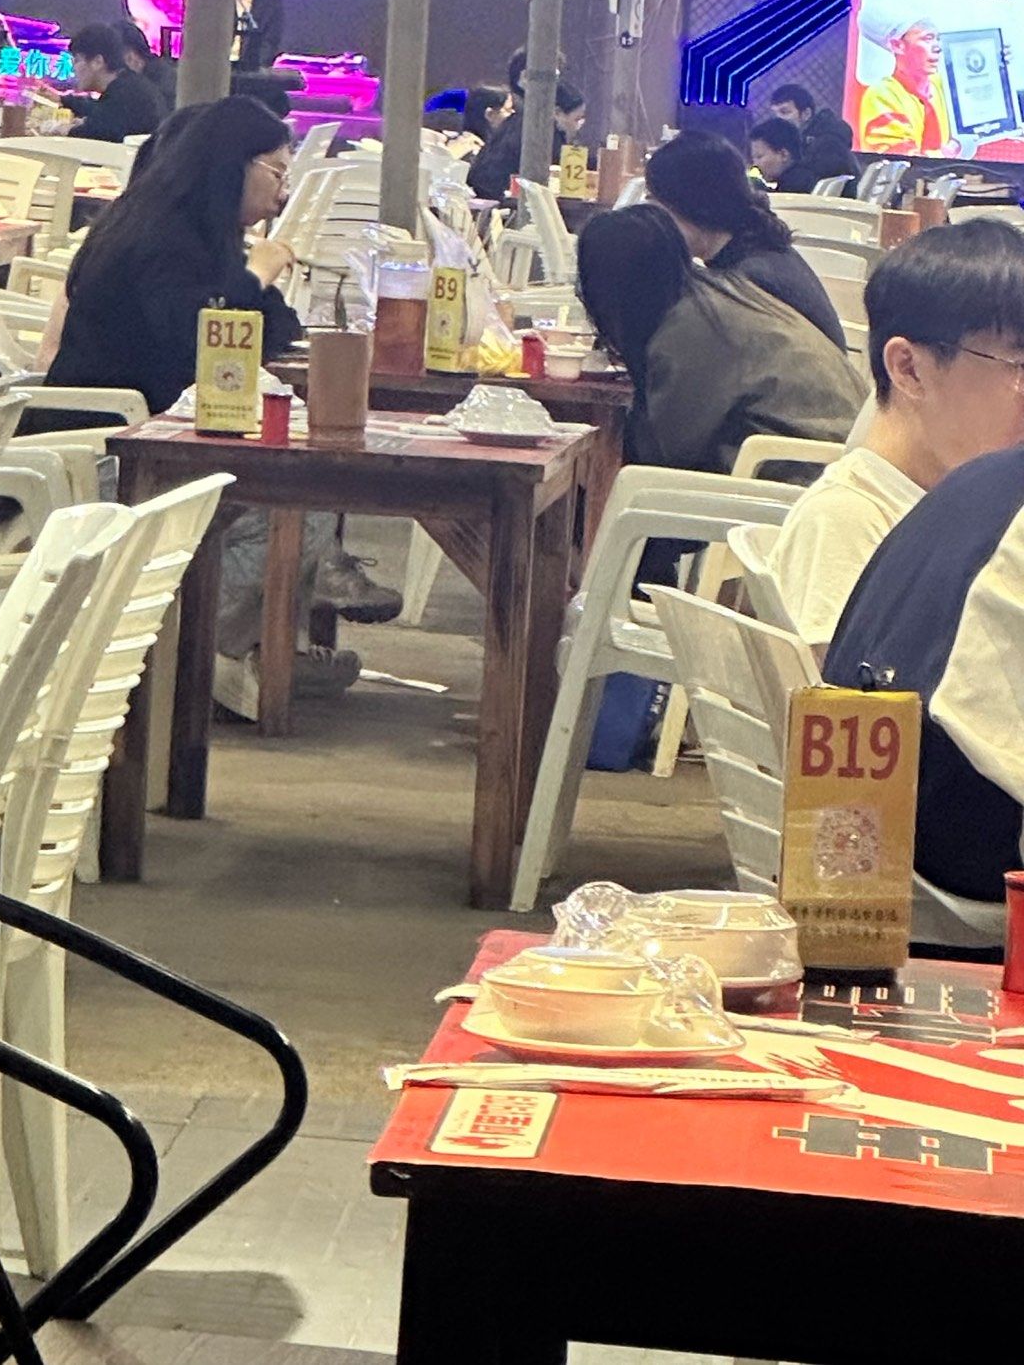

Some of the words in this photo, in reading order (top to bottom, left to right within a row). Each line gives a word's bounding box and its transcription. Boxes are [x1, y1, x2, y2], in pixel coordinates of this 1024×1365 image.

[565, 165, 584, 180] 12
[435, 276, 457, 301] B9
[206, 320, 253, 350] B12
[801, 714, 900, 781] B19
